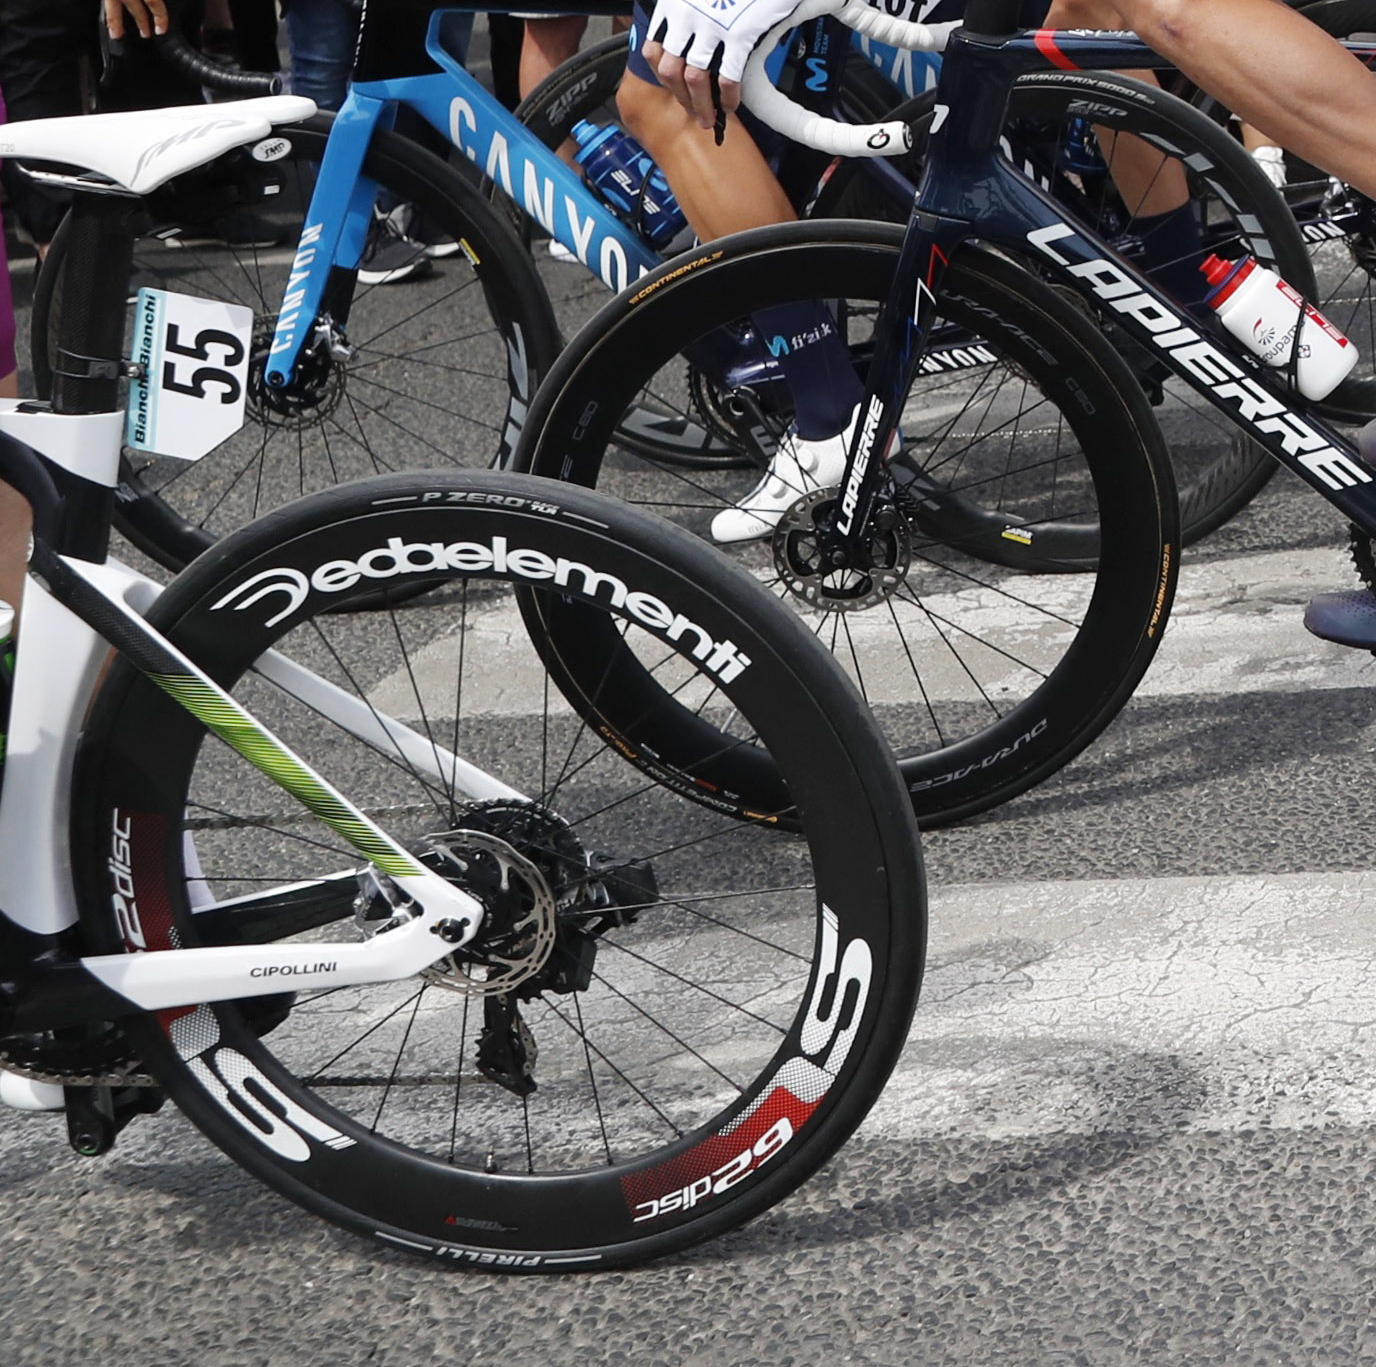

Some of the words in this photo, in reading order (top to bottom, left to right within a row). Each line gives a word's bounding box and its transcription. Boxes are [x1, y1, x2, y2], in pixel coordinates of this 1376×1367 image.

[546, 72, 598, 120] ZIPP
[1063, 75, 1098, 85] PRIX
[449, 96, 650, 298] CANYO
[271, 223, 323, 355] CANYON
[636, 256, 713, 300] CONTINENTAL
[140, 293, 157, 365] Bianchi
[163, 322, 246, 406] 55
[1027, 222, 1373, 491] LAPIERRE
[420, 491, 443, 503] P
[444, 491, 528, 508] ZERO
[837, 392, 887, 537] LAPIERRE
[210, 536, 753, 685] Dedaelementi
[1150, 553, 1171, 631] CONTINENTAL
[911, 717, 1049, 792] DURA-ACE
[109, 807, 147, 950] 2disc
[250, 961, 338, 979] CIPOLLINI
[633, 1116, 795, 1224] 62disc
[436, 1245, 543, 1268] PIRELLI
